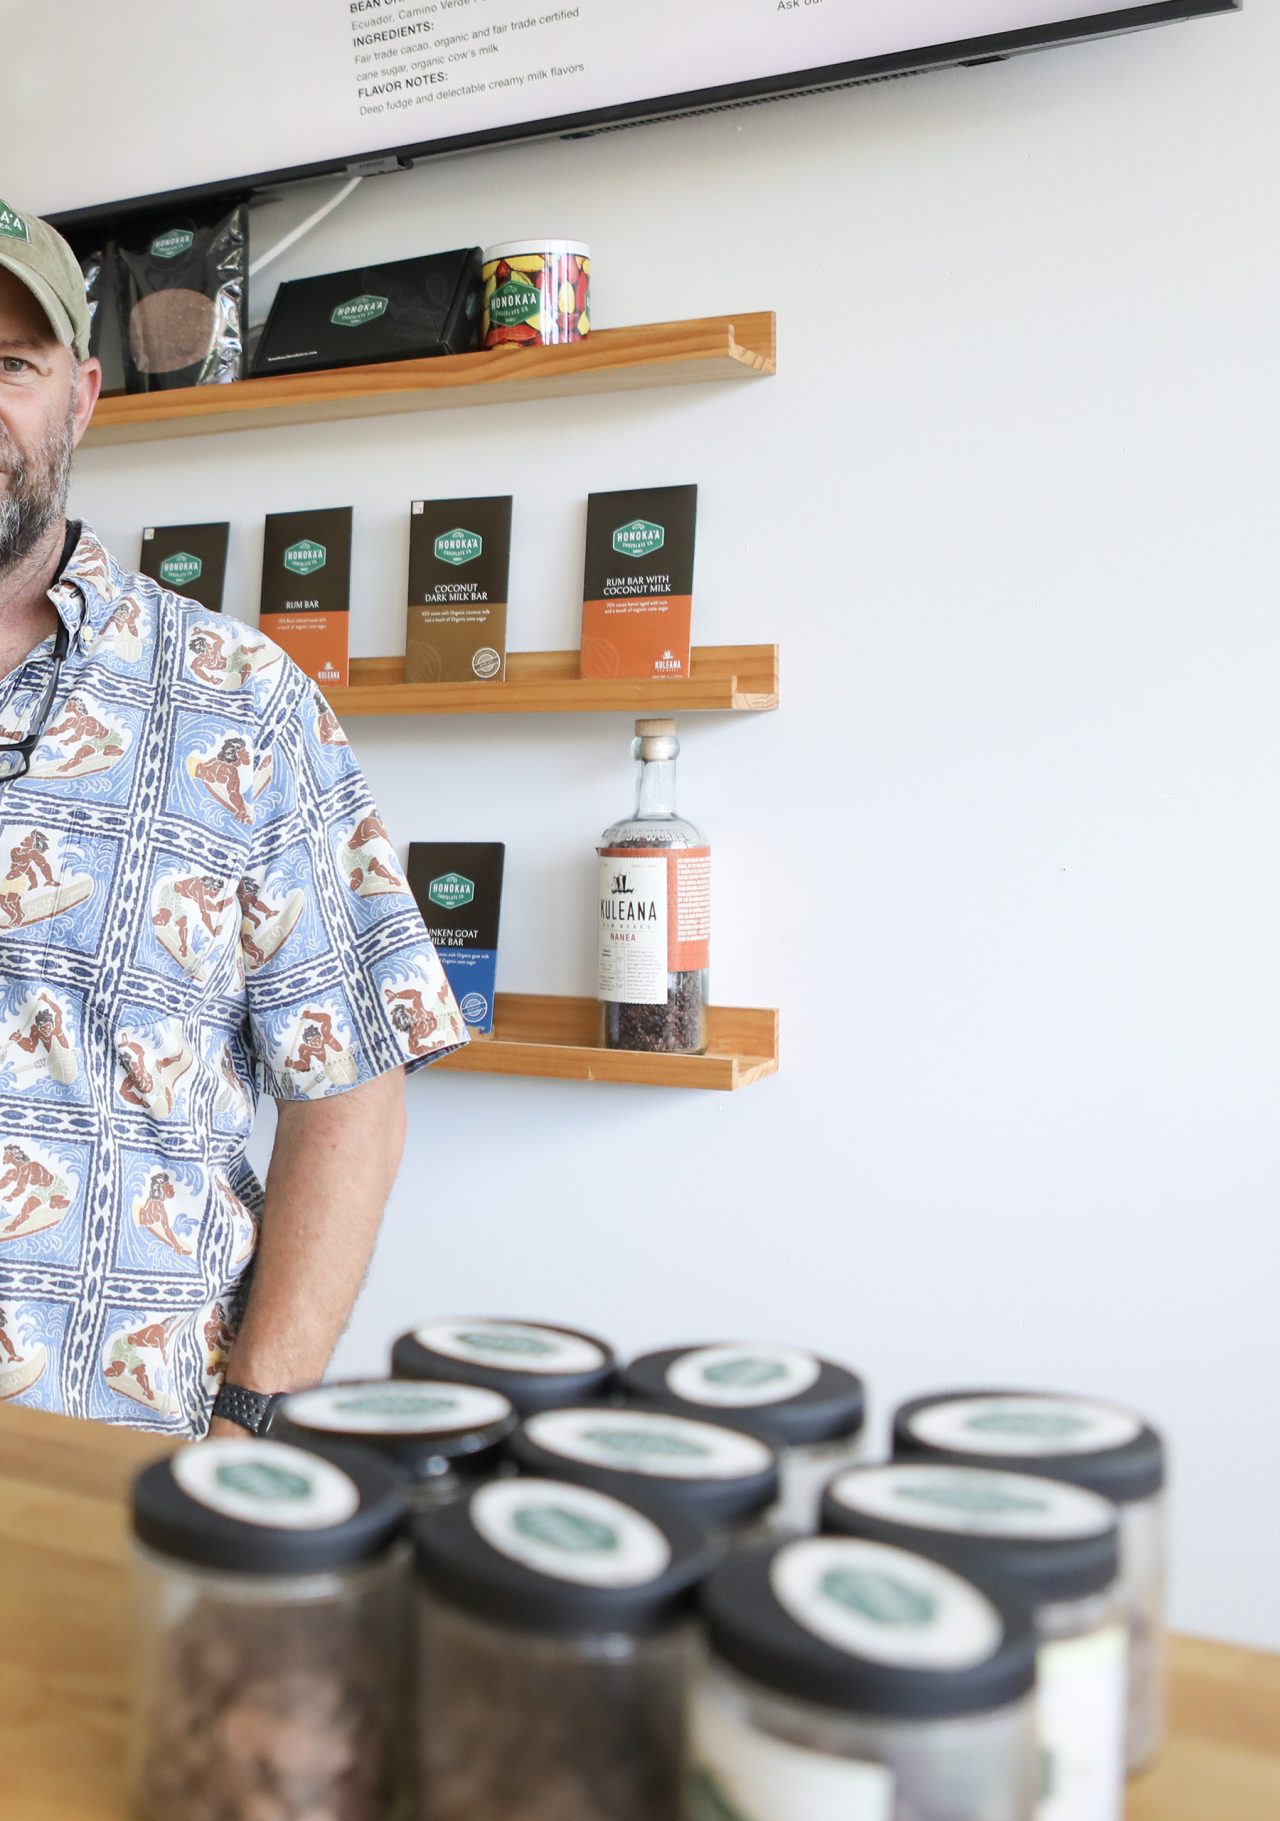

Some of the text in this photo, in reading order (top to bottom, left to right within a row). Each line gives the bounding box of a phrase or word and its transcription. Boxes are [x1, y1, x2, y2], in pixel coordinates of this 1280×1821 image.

[350, 0, 380, 13] BEAN
[777, 0, 800, 11] Ask
[351, 15, 395, 31] Ecuador,
[398, 4, 438, 20] Camino
[353, 21, 434, 48] INGREDIENTS:
[355, 8, 580, 64] Fair trade cacao, organic and fair trade certified
[356, 44, 499, 82] cane sugar, organic cow's milk
[358, 71, 448, 99] FLAVOR NOTES:
[360, 63, 585, 116] Deep fudge and delectable creamy milk flavors
[491, 292, 537, 310] HONOKA'A
[617, 530, 661, 542] HONOKA'A
[606, 574, 669, 587] RUM BAR WITH
[434, 583, 478, 593] COCONUT
[603, 583, 671, 596] COCONUT MILK
[425, 591, 488, 602] DARK MILK BAR
[286, 600, 319, 609] RUM BAR
[600, 899, 657, 921] KULEANA
[455, 929, 479, 939] GOAT
[610, 932, 636, 942] NANEA
[448, 937, 464, 946] BAR
